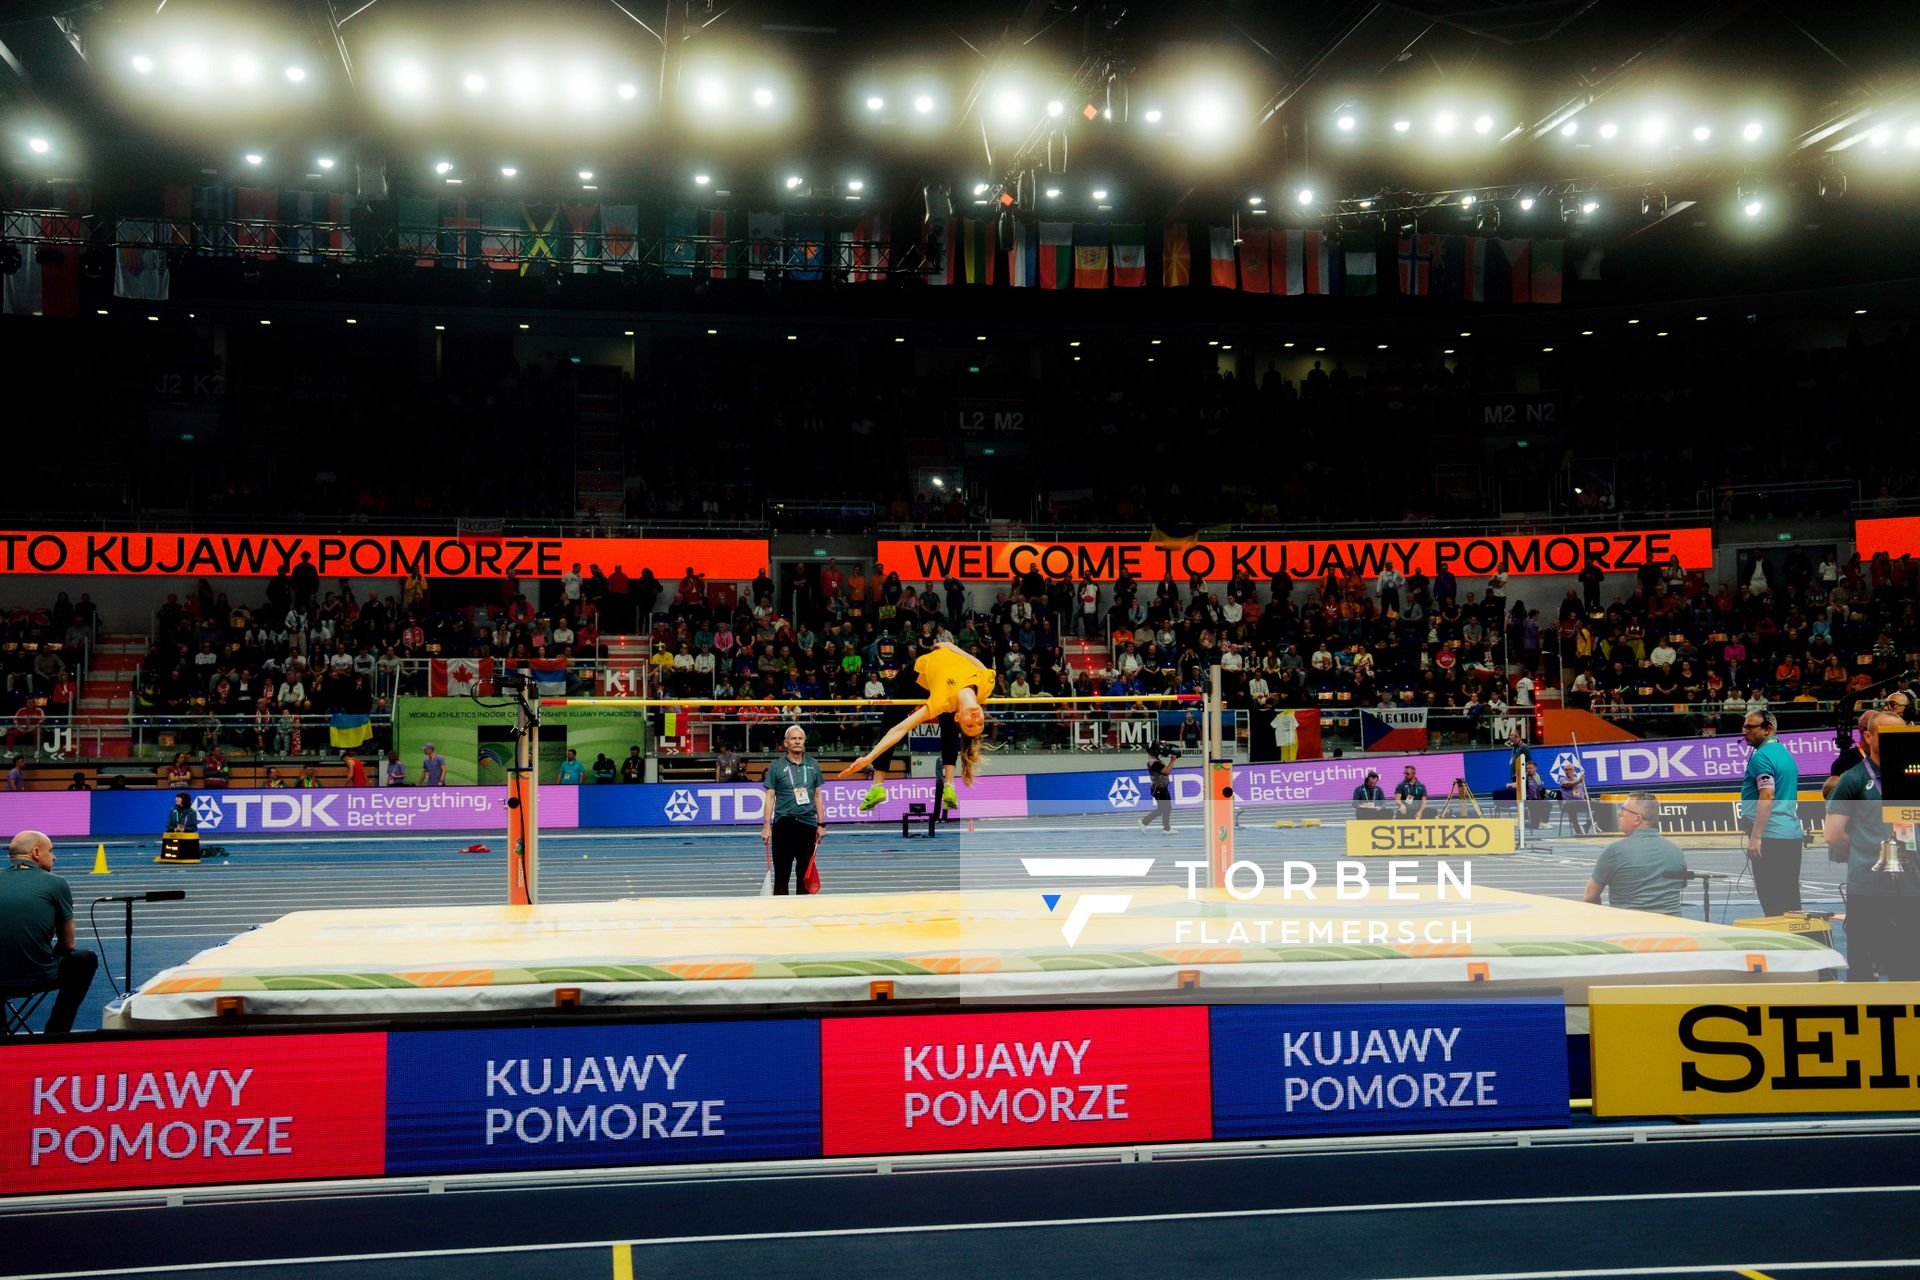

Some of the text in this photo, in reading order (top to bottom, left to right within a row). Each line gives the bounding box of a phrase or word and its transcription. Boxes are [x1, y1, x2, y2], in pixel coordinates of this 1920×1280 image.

[959, 411, 1025, 430] L2 M2
[1483, 402, 1557, 424] M2 N2
[0, 535, 562, 575] TO KUJAWY POMORZE
[915, 534, 1672, 578] WELCOME TO KUJAWY POMORZE
[606, 669, 635, 692] K1
[43, 727, 72, 753] J1
[911, 724, 940, 736] KLAV
[1074, 721, 1099, 744] L1
[1120, 721, 1152, 744] M1
[1494, 717, 1526, 740] M1
[1582, 745, 1698, 782] TDK
[1703, 744, 1721, 759] In
[1250, 770, 1266, 785] In
[1704, 760, 1748, 776] Bett
[347, 792, 492, 813] In Everything,
[698, 788, 765, 821] TD
[1250, 786, 1313, 801] Better
[222, 794, 340, 828] TDK
[347, 811, 417, 827] Better
[823, 803, 875, 819] etter
[1371, 824, 1491, 850] SEIKO
[1789, 922, 1810, 932] SEIKO
[1284, 1027, 1461, 1067] KUJAWY
[1678, 1004, 1920, 1093] SEI
[904, 1040, 1091, 1081] KUJAWY
[486, 1053, 688, 1096] KUJAWY
[32, 1068, 254, 1115] KUJAWY
[1285, 1072, 1498, 1112] POMORZE
[904, 1085, 1128, 1128] POMORZE
[486, 1100, 725, 1145] POMORZE
[30, 1116, 293, 1166] POMORZE
